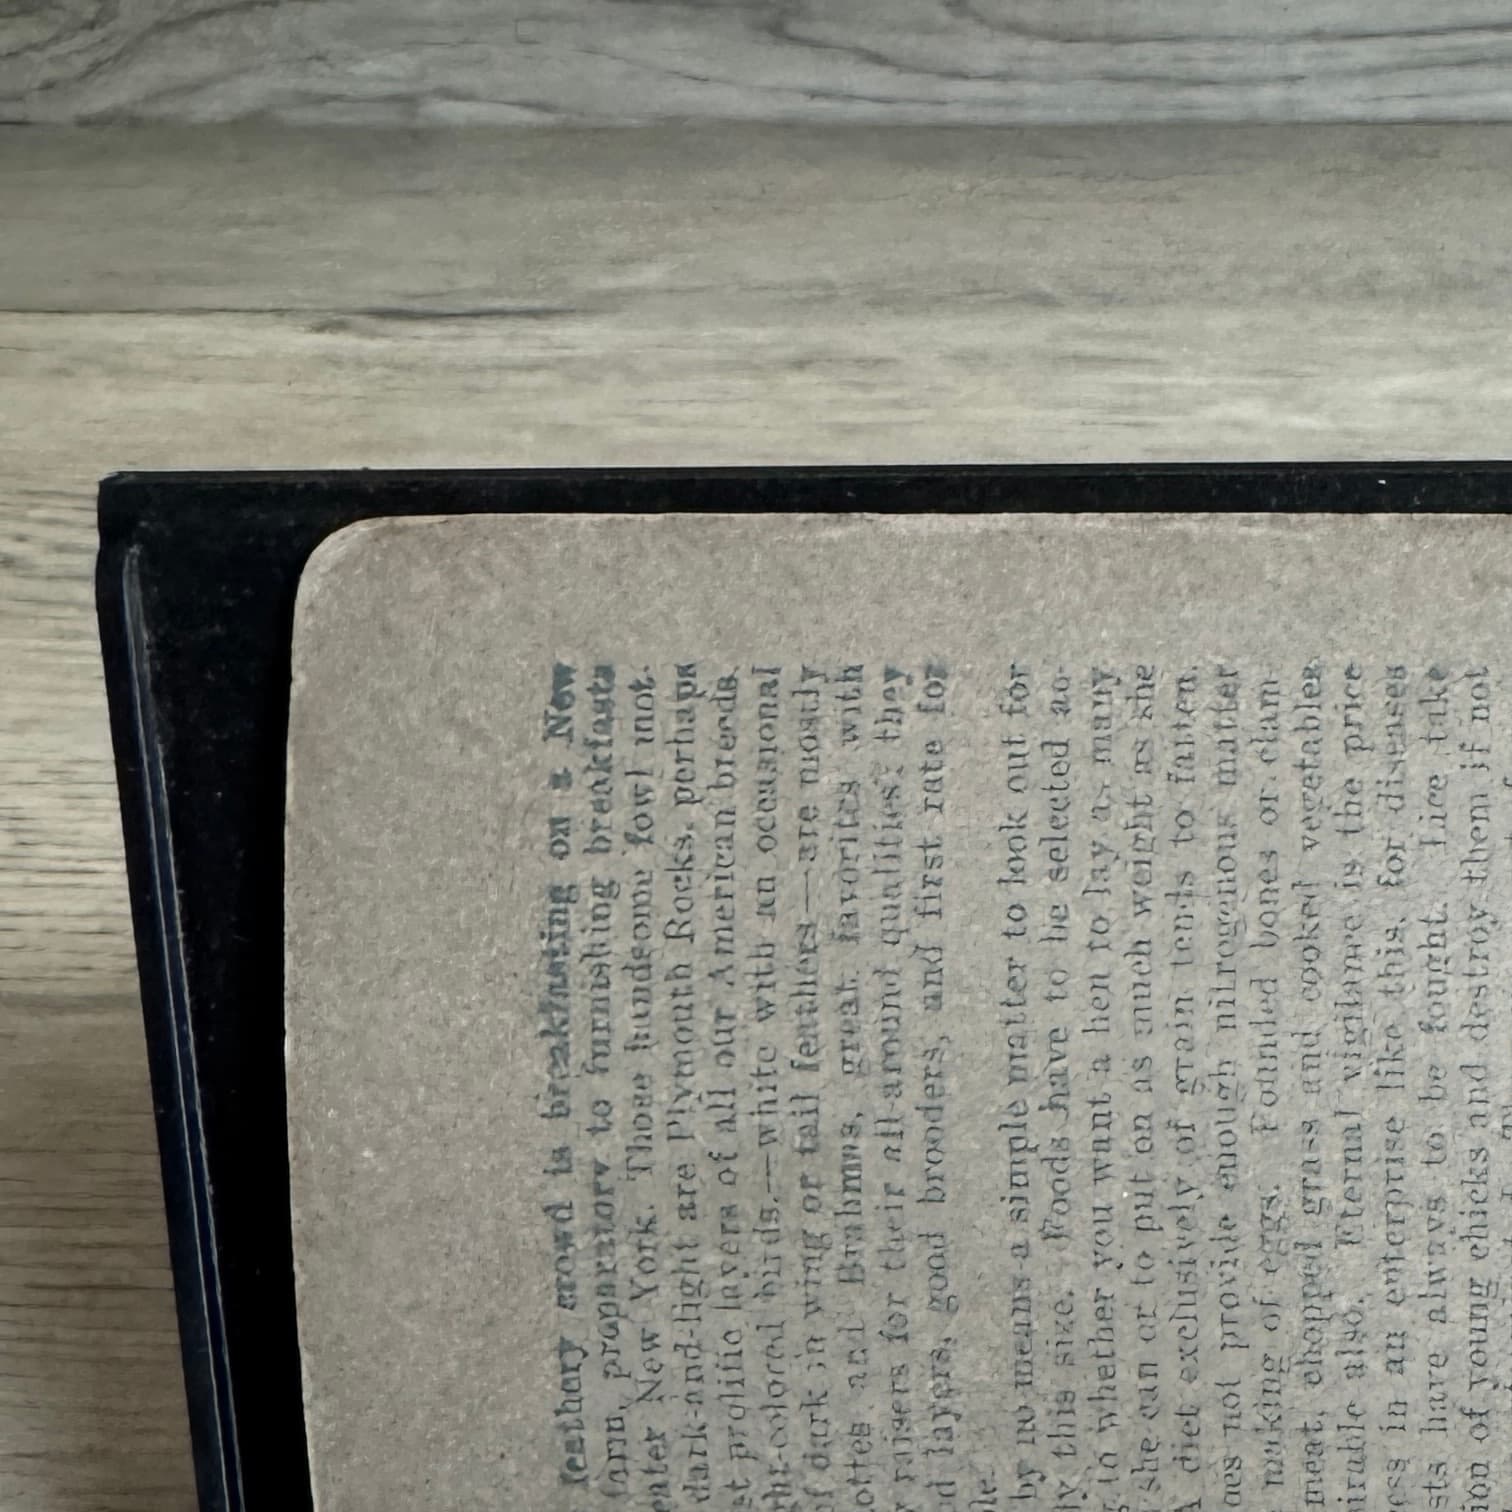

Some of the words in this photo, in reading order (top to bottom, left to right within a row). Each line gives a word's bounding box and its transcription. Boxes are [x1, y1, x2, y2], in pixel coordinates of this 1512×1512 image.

[794, 665, 828, 787] mostly
[838, 665, 863, 748] with
[876, 665, 912, 742] they
[1001, 665, 1031, 717] for
[1337, 663, 1373, 753] price
[1419, 667, 1447, 742] take
[1461, 667, 1489, 721] not
[584, 665, 613, 852] breakfasts
[675, 664, 703, 804] perhaps
[1003, 737, 1026, 792] out
[1461, 741, 1489, 770] if
[626, 771, 652, 844] fowl
[920, 741, 941, 813] rate
[1043, 740, 1070, 880] selected
[1335, 780, 1362, 835] the
[1001, 809, 1026, 884] look
[1085, 841, 1118, 896] lay
[1128, 794, 1156, 917] weight
[1379, 841, 1403, 886] for
[1463, 794, 1489, 882] them
[713, 810, 736, 984] American
[915, 837, 941, 920] first
[1004, 905, 1025, 939] to
[1293, 881, 1320, 1001] cooked
[1377, 919, 1407, 993] this,
[584, 879, 618, 1073] furnishing
[1083, 974, 1111, 1032] hen
[1461, 905, 1496, 1041] destroy
[665, 964, 700, 1140] Plymouth
[715, 1012, 735, 1066] our
[1003, 957, 1026, 1083] matter
[1173, 995, 1204, 1095] grain
[1378, 1024, 1403, 1088] like
[1042, 1028, 1069, 1112] have
[1419, 1065, 1445, 1100] be
[1460, 1065, 1488, 1128] and
[588, 1101, 611, 1133] to
[792, 1095, 819, 1154] tail
[919, 1035, 949, 1203] brooders,
[1087, 1093, 1111, 1184] want
[1133, 1114, 1153, 1153] on
[675, 1164, 696, 1220] are
[876, 1183, 904, 1270] their
[1125, 1175, 1161, 1232] put
[1259, 1185, 1290, 1272] eggs.
[1459, 1148, 1490, 1260] chicks
[632, 1204, 658, 1299] York.
[920, 1233, 958, 1311] good
[1090, 1206, 1122, 1269] you
[1168, 1179, 1206, 1379] exclusively
[1295, 1241, 1332, 1384] chopped
[637, 1329, 663, 1401] New
[1054, 1289, 1075, 1366] size.
[1089, 1289, 1117, 1432] whether
[1383, 1333, 1406, 1374] an
[1463, 1280, 1499, 1389] young
[1047, 1390, 1076, 1459] this
[1379, 1402, 1407, 1431] in
[1421, 1353, 1448, 1432] have
[1461, 1407, 1489, 1442] of
[1176, 1406, 1201, 1473] diet
